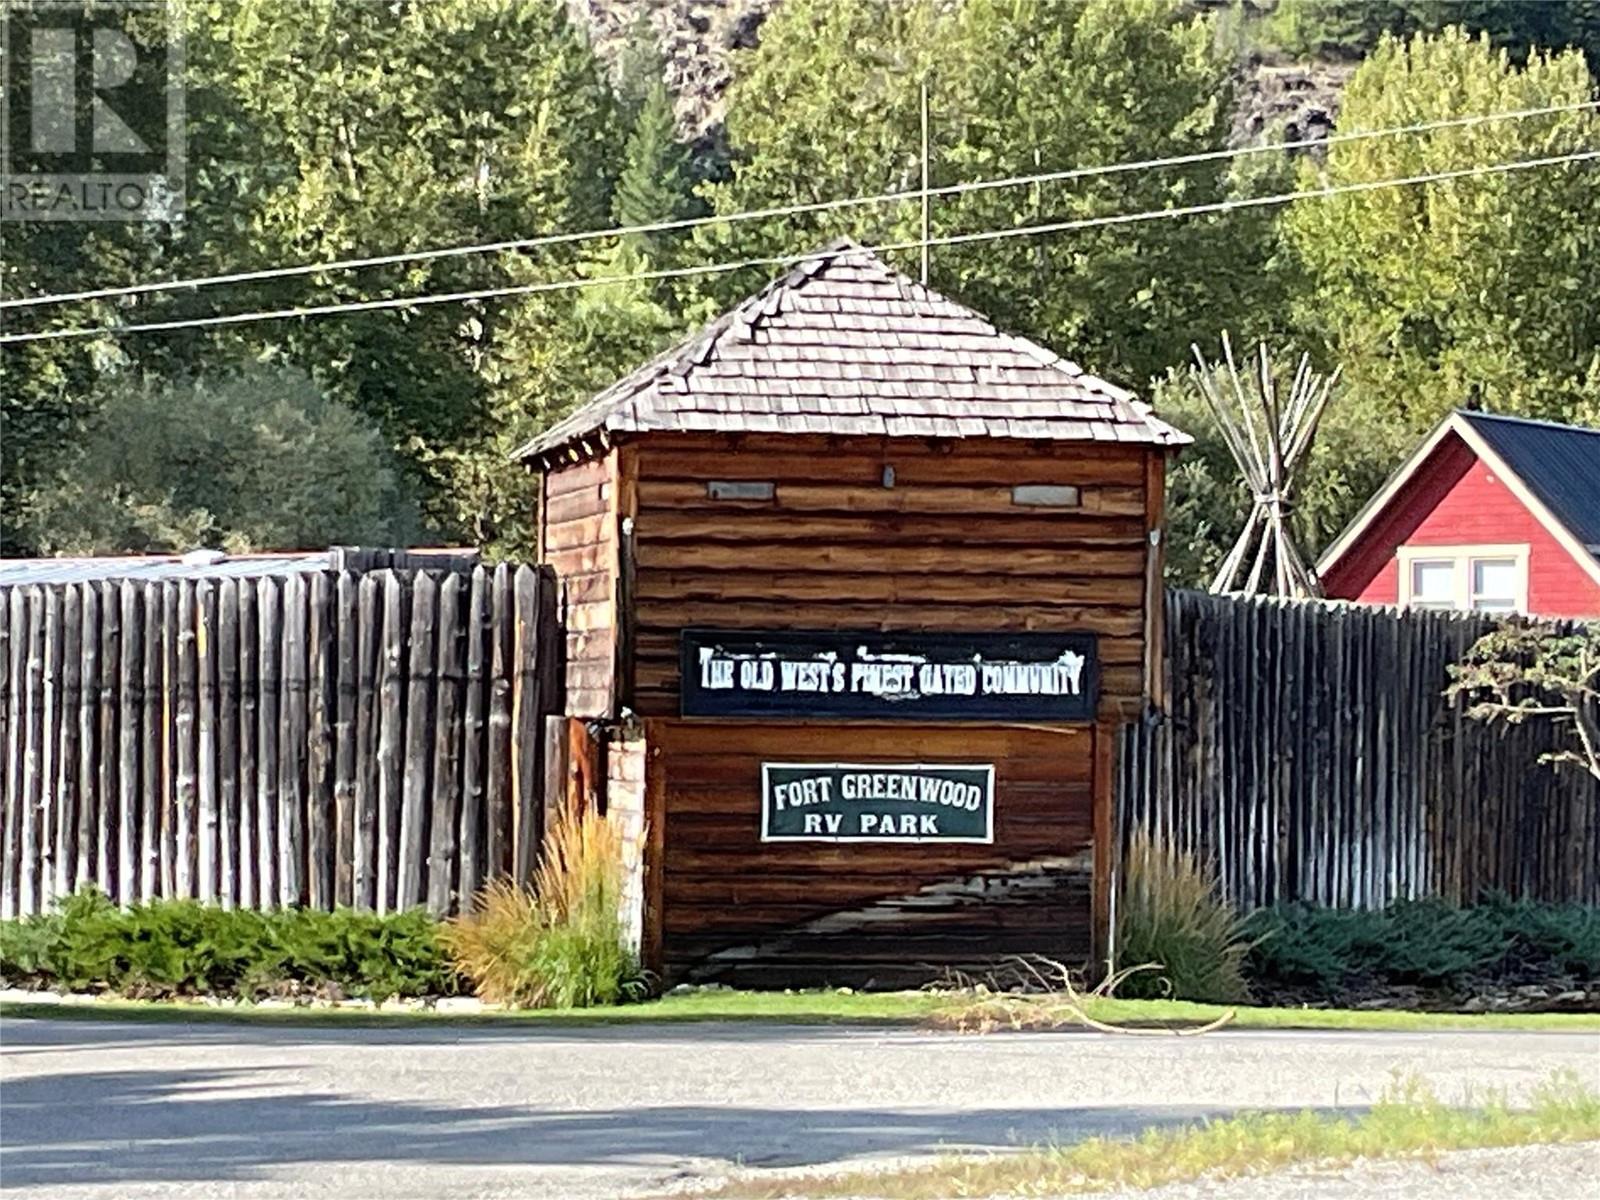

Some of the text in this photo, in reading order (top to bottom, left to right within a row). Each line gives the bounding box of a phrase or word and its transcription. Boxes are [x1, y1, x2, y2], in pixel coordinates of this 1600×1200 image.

[699, 647, 735, 689] THE
[740, 661, 774, 690] OLD
[780, 657, 846, 692] WEST'S
[919, 663, 977, 695] GATED
[982, 655, 1085, 695] COMMUNITY
[774, 774, 981, 811] FORT GREENWOOD
[804, 814, 939, 834] RV PARK
